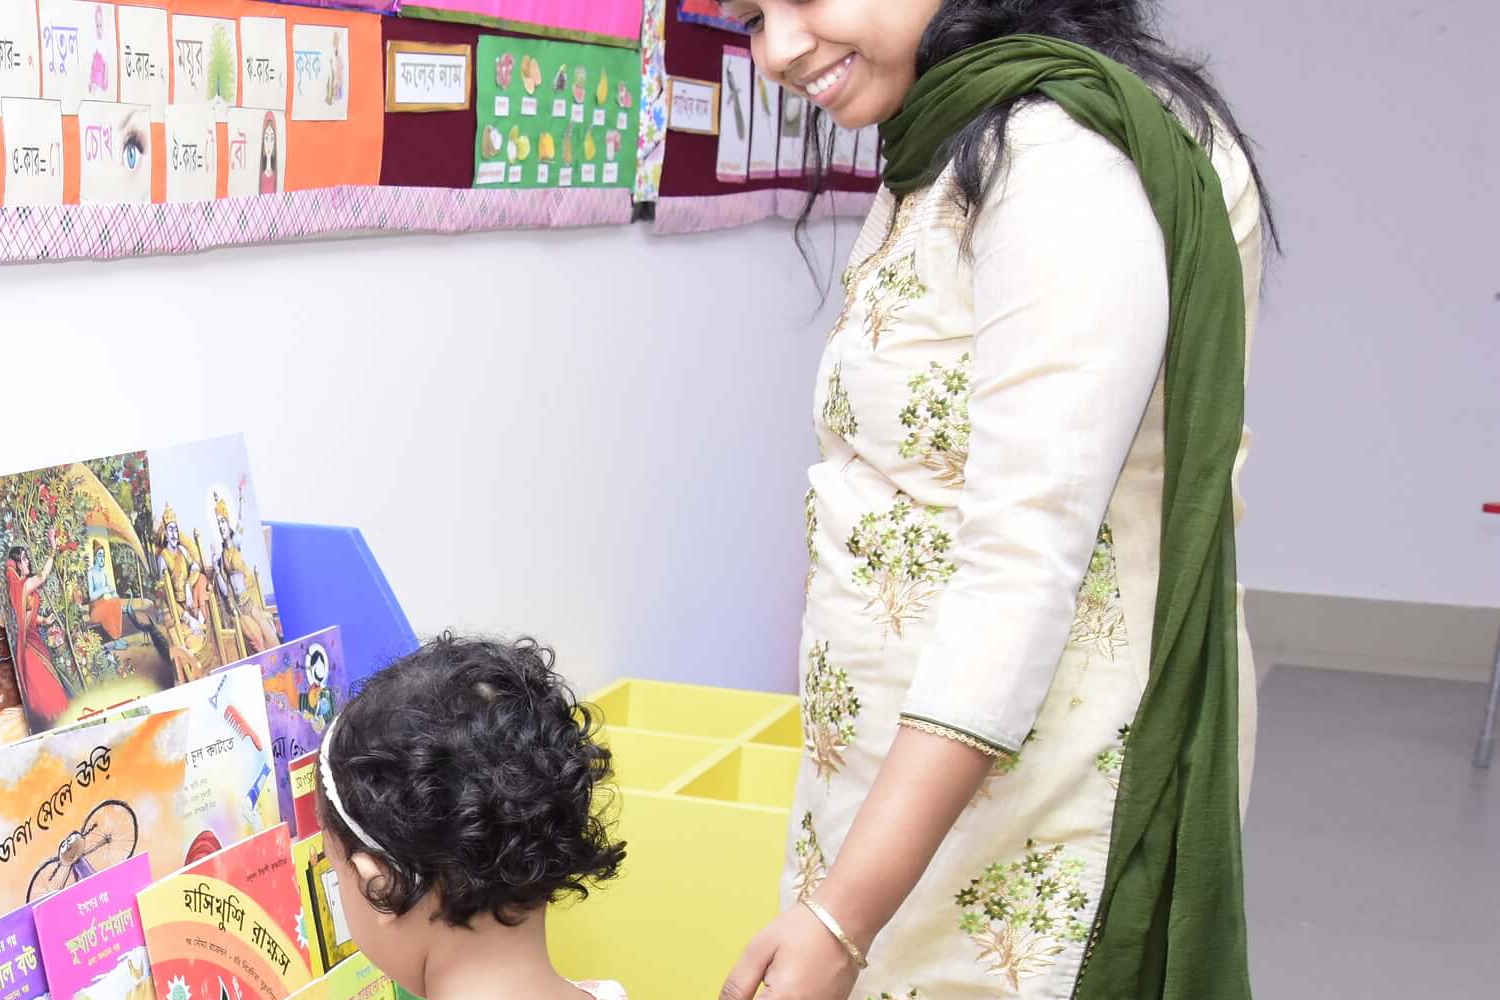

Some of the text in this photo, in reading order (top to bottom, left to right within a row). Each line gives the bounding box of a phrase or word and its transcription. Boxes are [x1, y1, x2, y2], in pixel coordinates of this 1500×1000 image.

[43, 23, 80, 77] পুতুল
[294, 50, 322, 96] কৃষক
[401, 62, 463, 92] ফলের নাম
[85, 124, 113, 161] চোখ
[231, 130, 248, 171] বৌ
[36, 779, 74, 831] মেলে
[75, 745, 112, 788] উড়ি
[183, 882, 246, 932] হাসিখুশি
[251, 920, 291, 976] রাক্ষস
[15, 945, 37, 976] বউ
